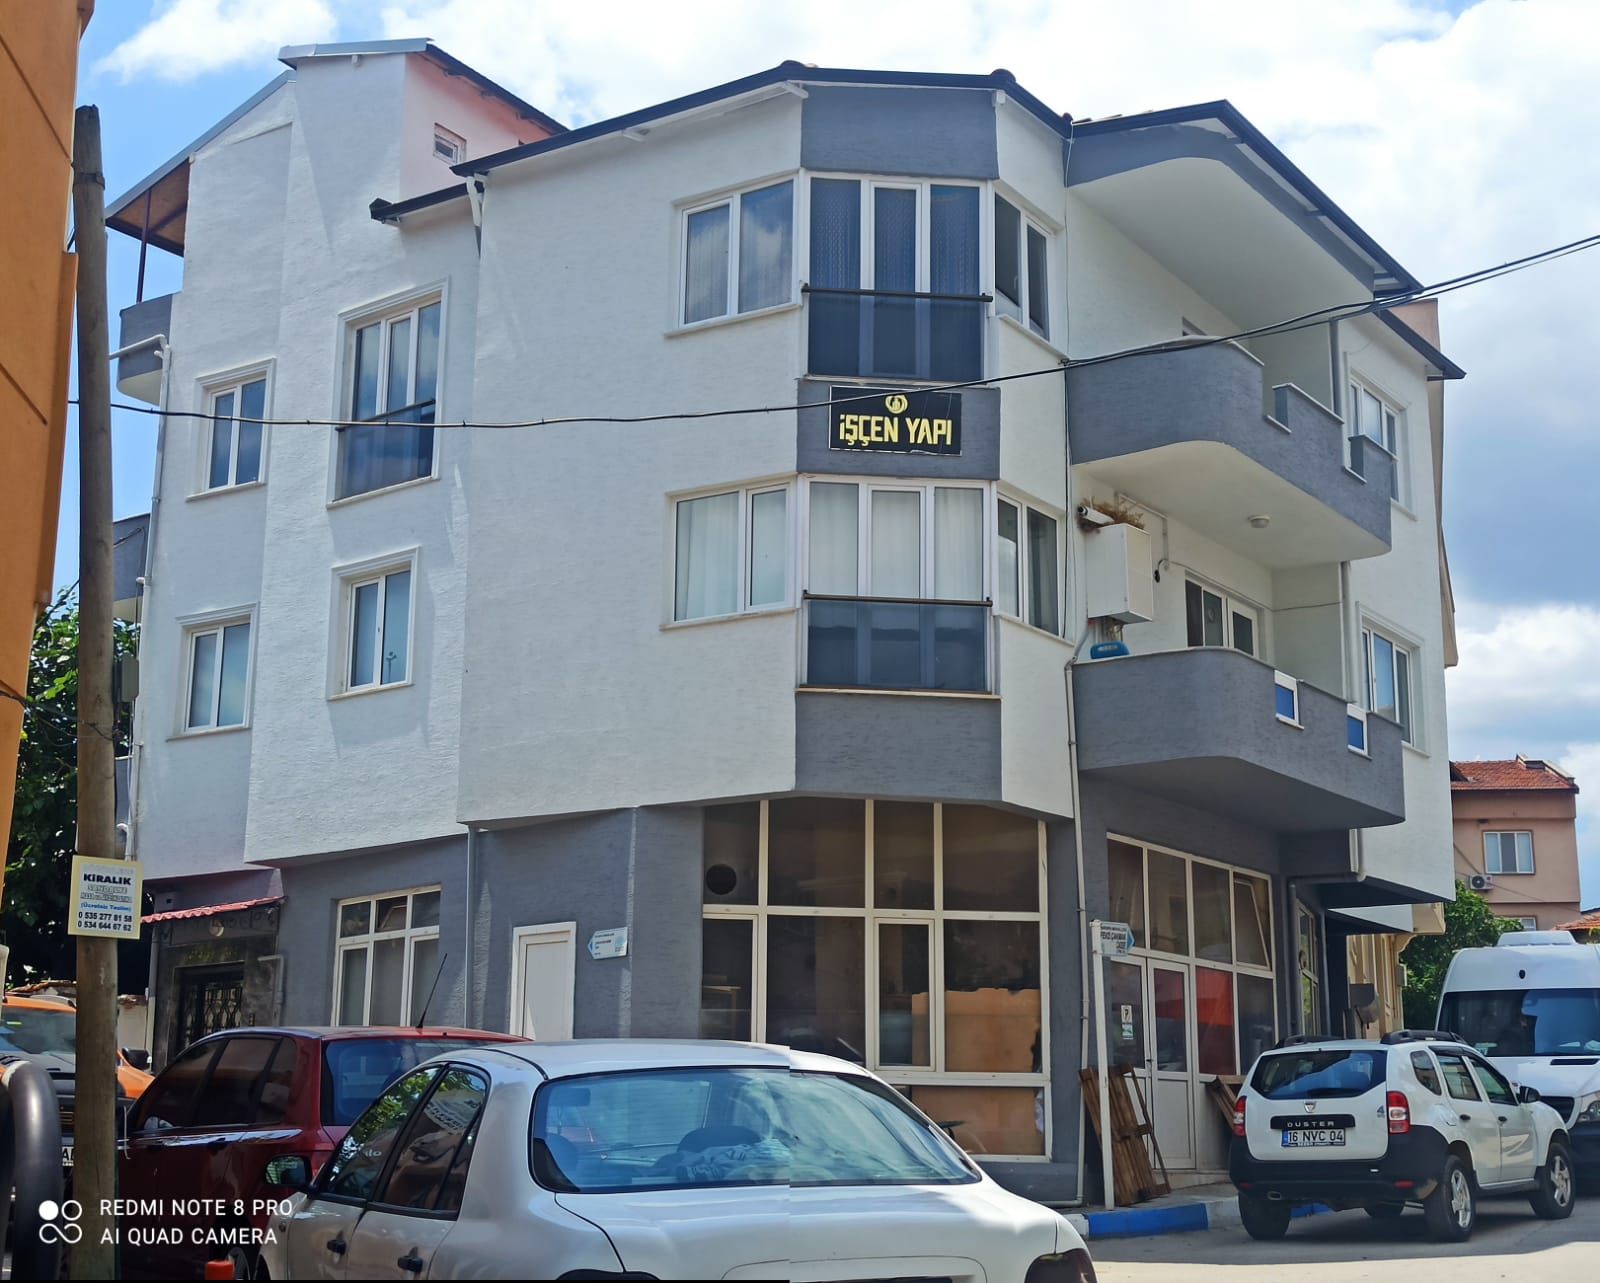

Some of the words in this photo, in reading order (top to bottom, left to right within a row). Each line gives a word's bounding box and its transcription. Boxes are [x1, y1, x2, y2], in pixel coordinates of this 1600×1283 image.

[839, 414, 899, 447] İŞÇEN
[905, 417, 953, 446] YAPI
[1287, 1120, 1335, 1128] DUSTER
[1289, 1131, 1298, 1143] 16
[1303, 1130, 1327, 1142] NVC
[1329, 1130, 1343, 1142] 04
